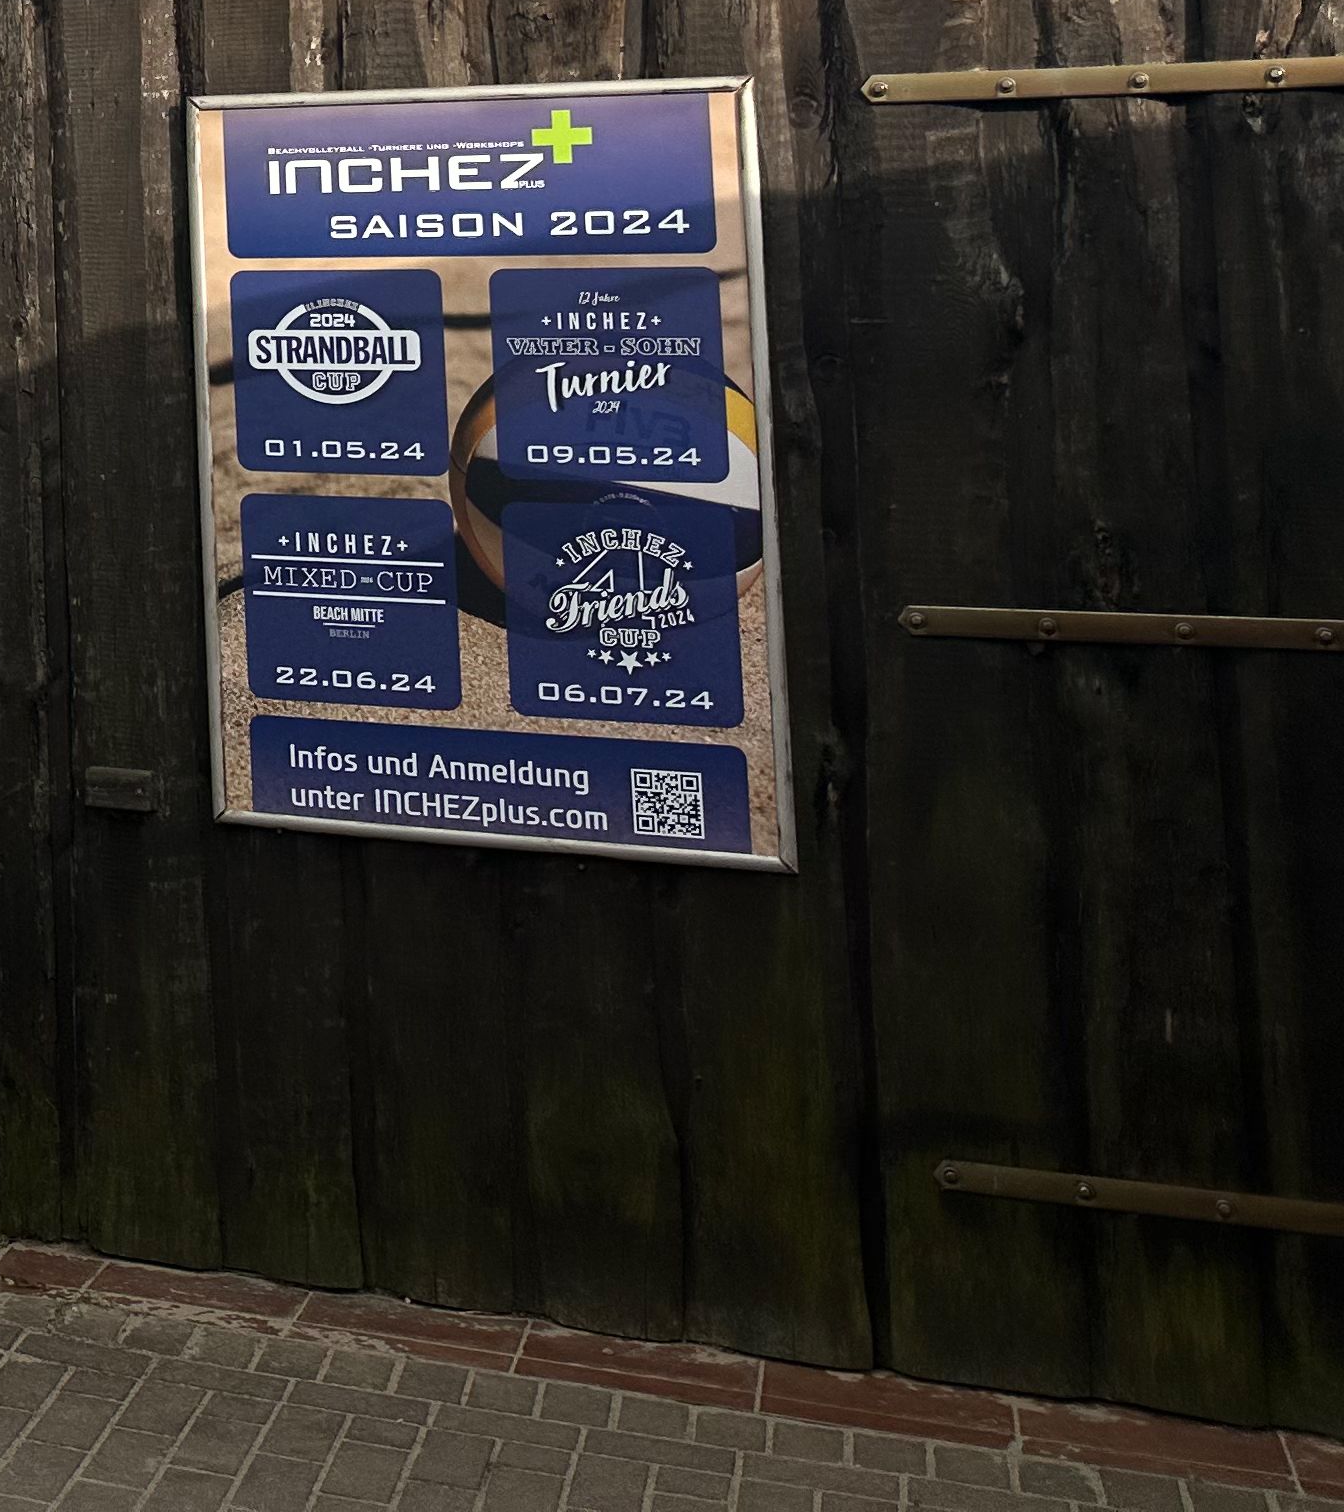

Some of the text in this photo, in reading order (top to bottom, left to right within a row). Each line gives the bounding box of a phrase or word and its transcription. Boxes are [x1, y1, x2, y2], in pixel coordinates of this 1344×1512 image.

[269, 153, 544, 195] INCHEZ
[330, 209, 691, 239] SAISON 2024
[310, 313, 355, 328] 2024
[256, 335, 415, 365] STRANDBALL
[506, 337, 599, 356] VATER
[620, 337, 701, 356] SOHN
[312, 372, 361, 391] CUP
[535, 360, 671, 413] Turnier
[592, 400, 621, 414] 2024
[265, 440, 424, 460] 01.05.24
[527, 445, 701, 466] 09.05.24
[562, 529, 686, 567] INCHEZ
[264, 565, 357, 589] MIXED
[377, 570, 433, 593] CUP
[313, 605, 385, 623] BEACH MITTE
[546, 568, 689, 633] Friends
[658, 609, 695, 629] 2024
[329, 628, 370, 639] BERLIN
[599, 627, 661, 649] CUP
[276, 666, 436, 694] 22.06.24
[538, 682, 714, 710] 06.07.24
[289, 743, 589, 796] Infos und Anmeldung
[291, 785, 609, 831] unter INCHEZplus.com
